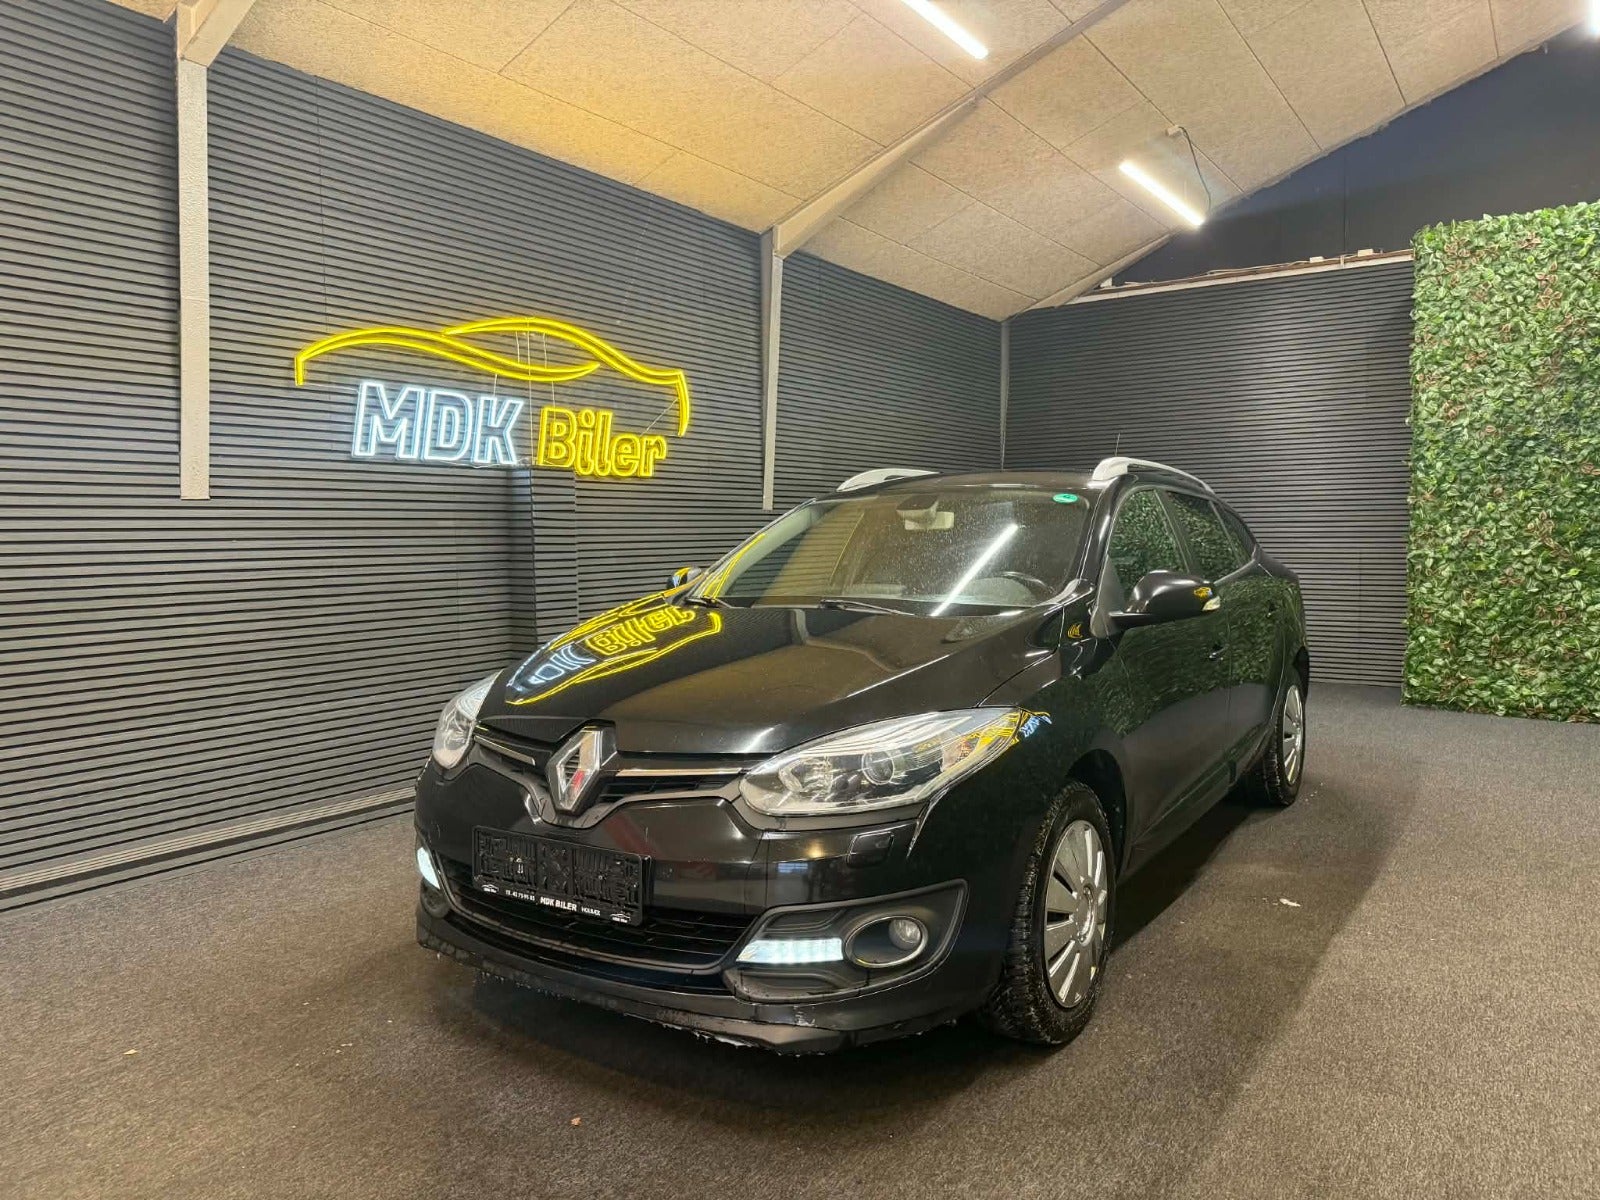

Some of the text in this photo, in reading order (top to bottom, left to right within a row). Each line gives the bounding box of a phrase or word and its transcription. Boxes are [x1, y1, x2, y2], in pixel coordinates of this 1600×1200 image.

[351, 381, 668, 477] MDK Biler
[540, 896, 555, 907] MDK
[555, 899, 578, 912] BILER
